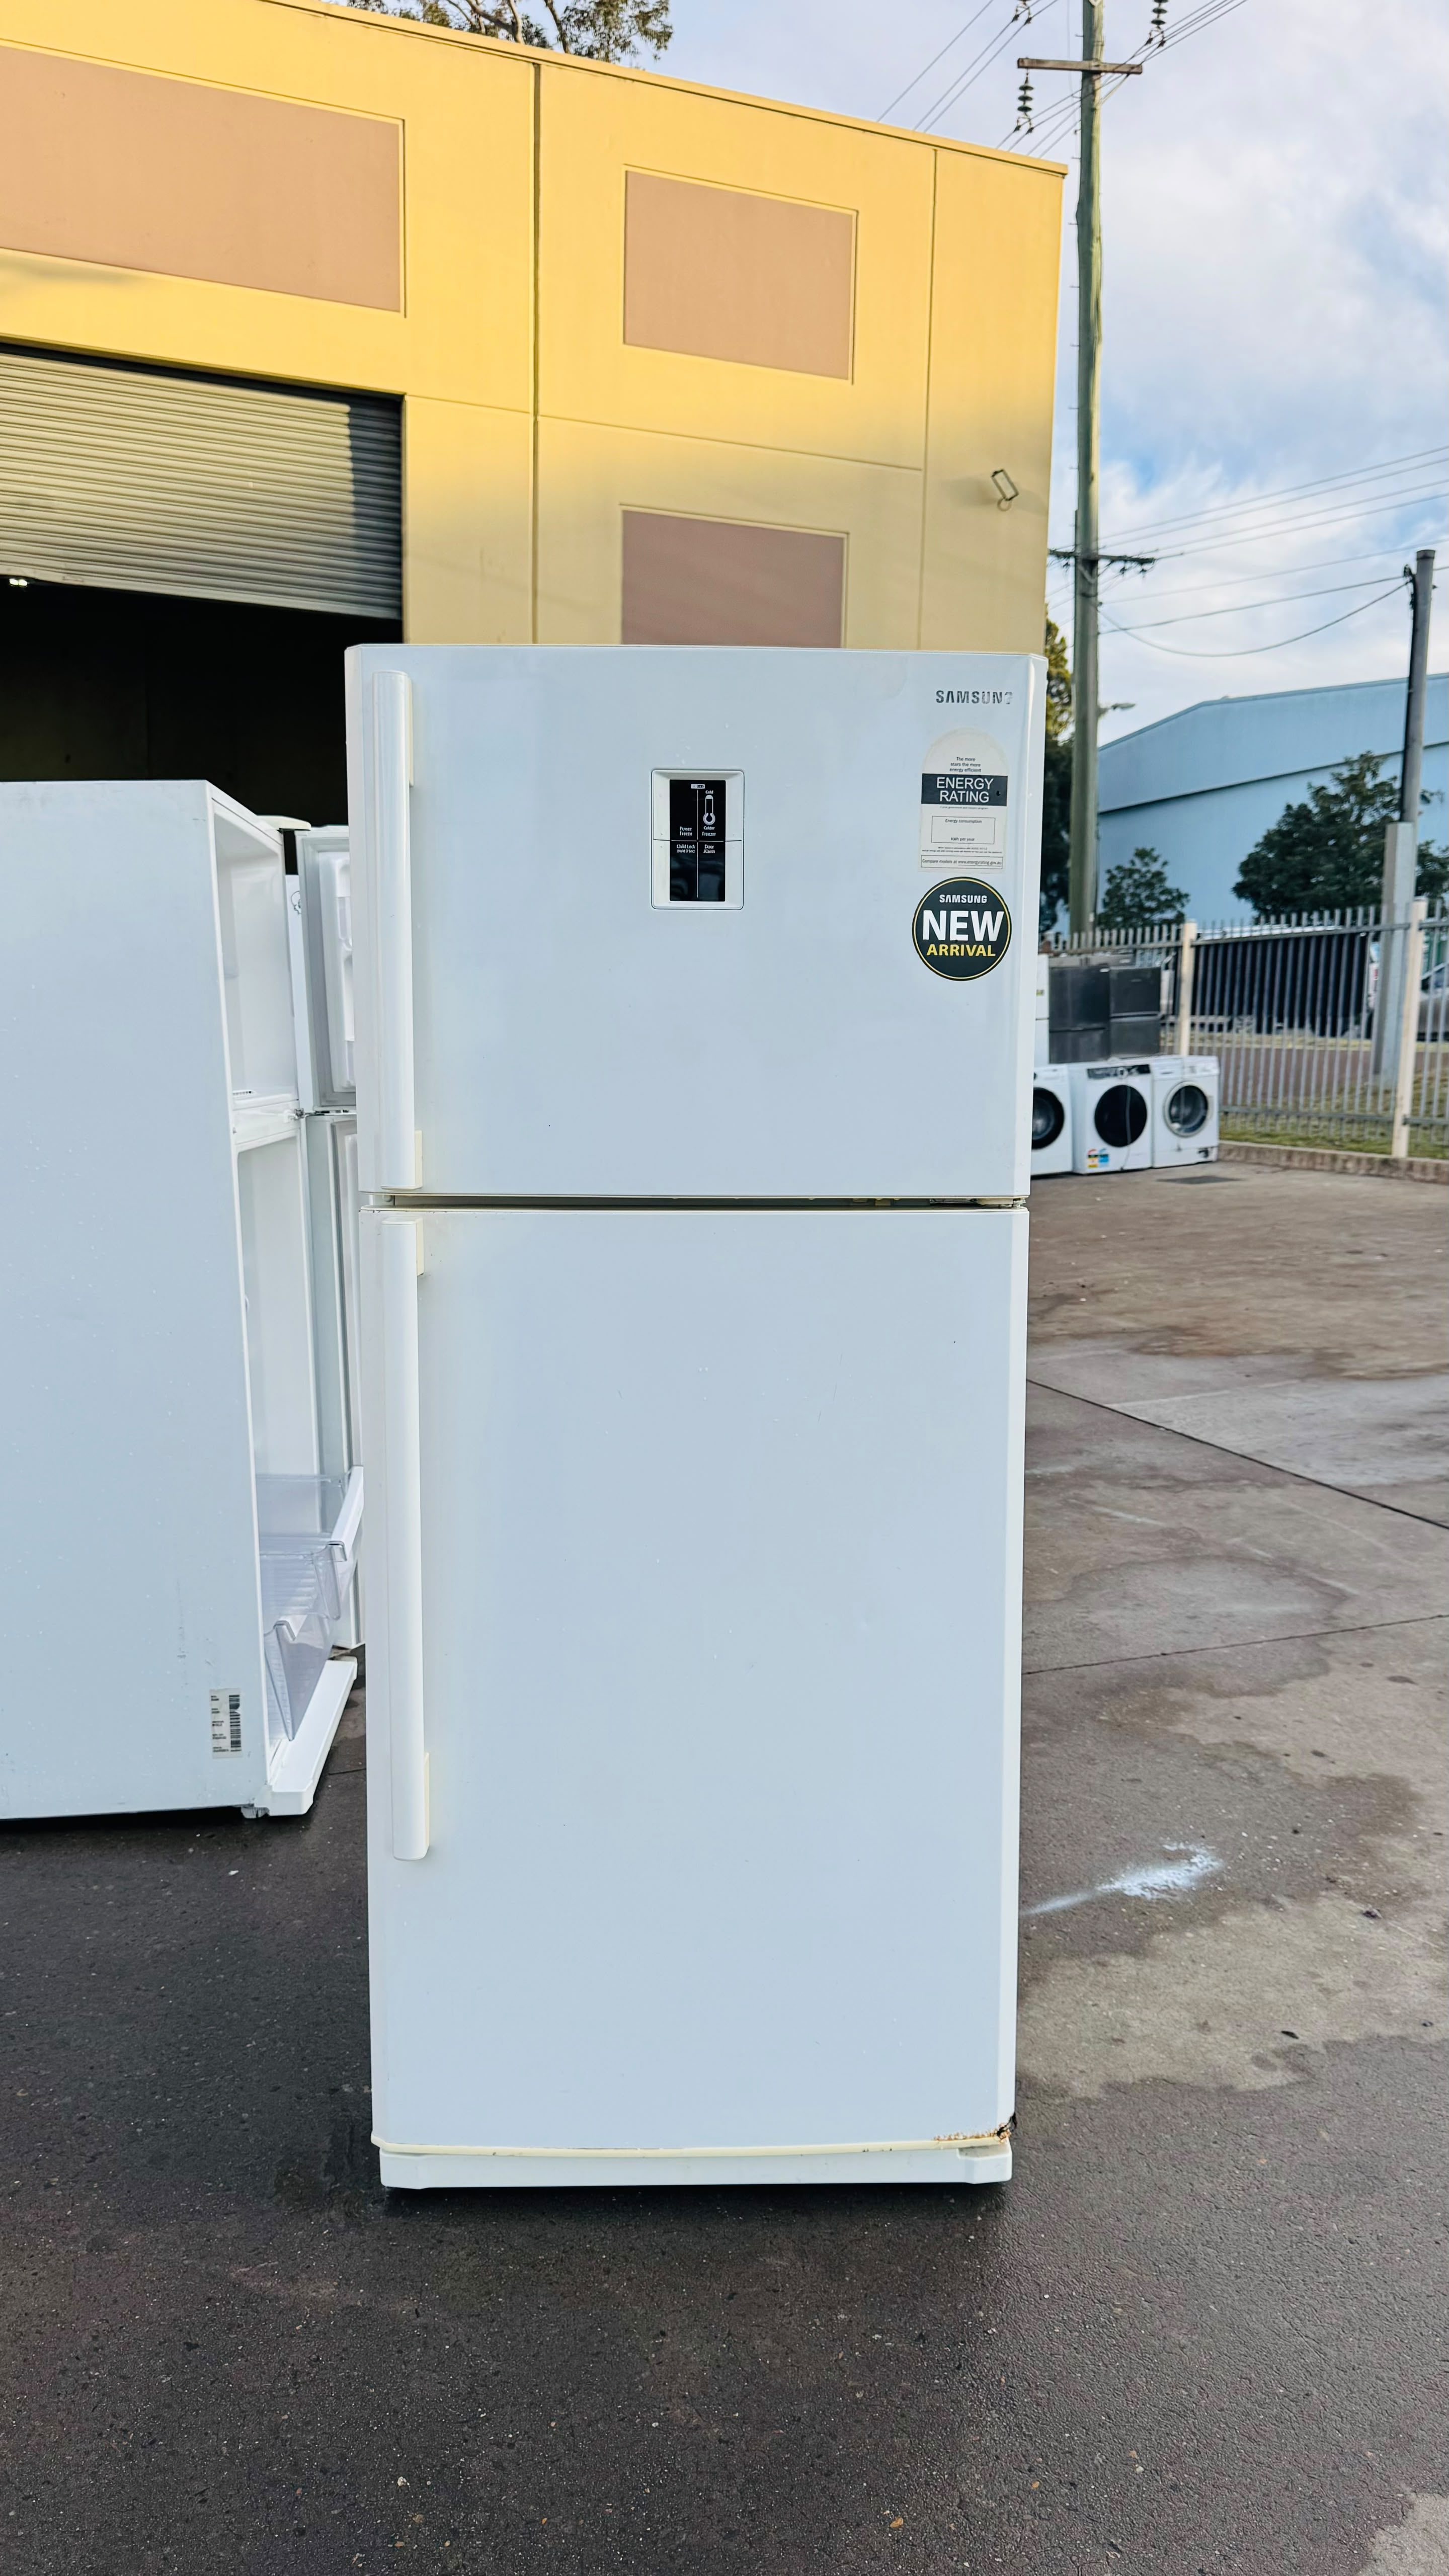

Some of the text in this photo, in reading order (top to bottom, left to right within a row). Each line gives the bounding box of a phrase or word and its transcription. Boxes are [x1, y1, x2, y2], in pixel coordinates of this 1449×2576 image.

[937, 777, 994, 789] ENERGY
[940, 790, 990, 803] RATING
[939, 895, 988, 903] SAMSUNG
[923, 910, 1004, 941] NEW
[926, 944, 996, 956] ARRIVAL
